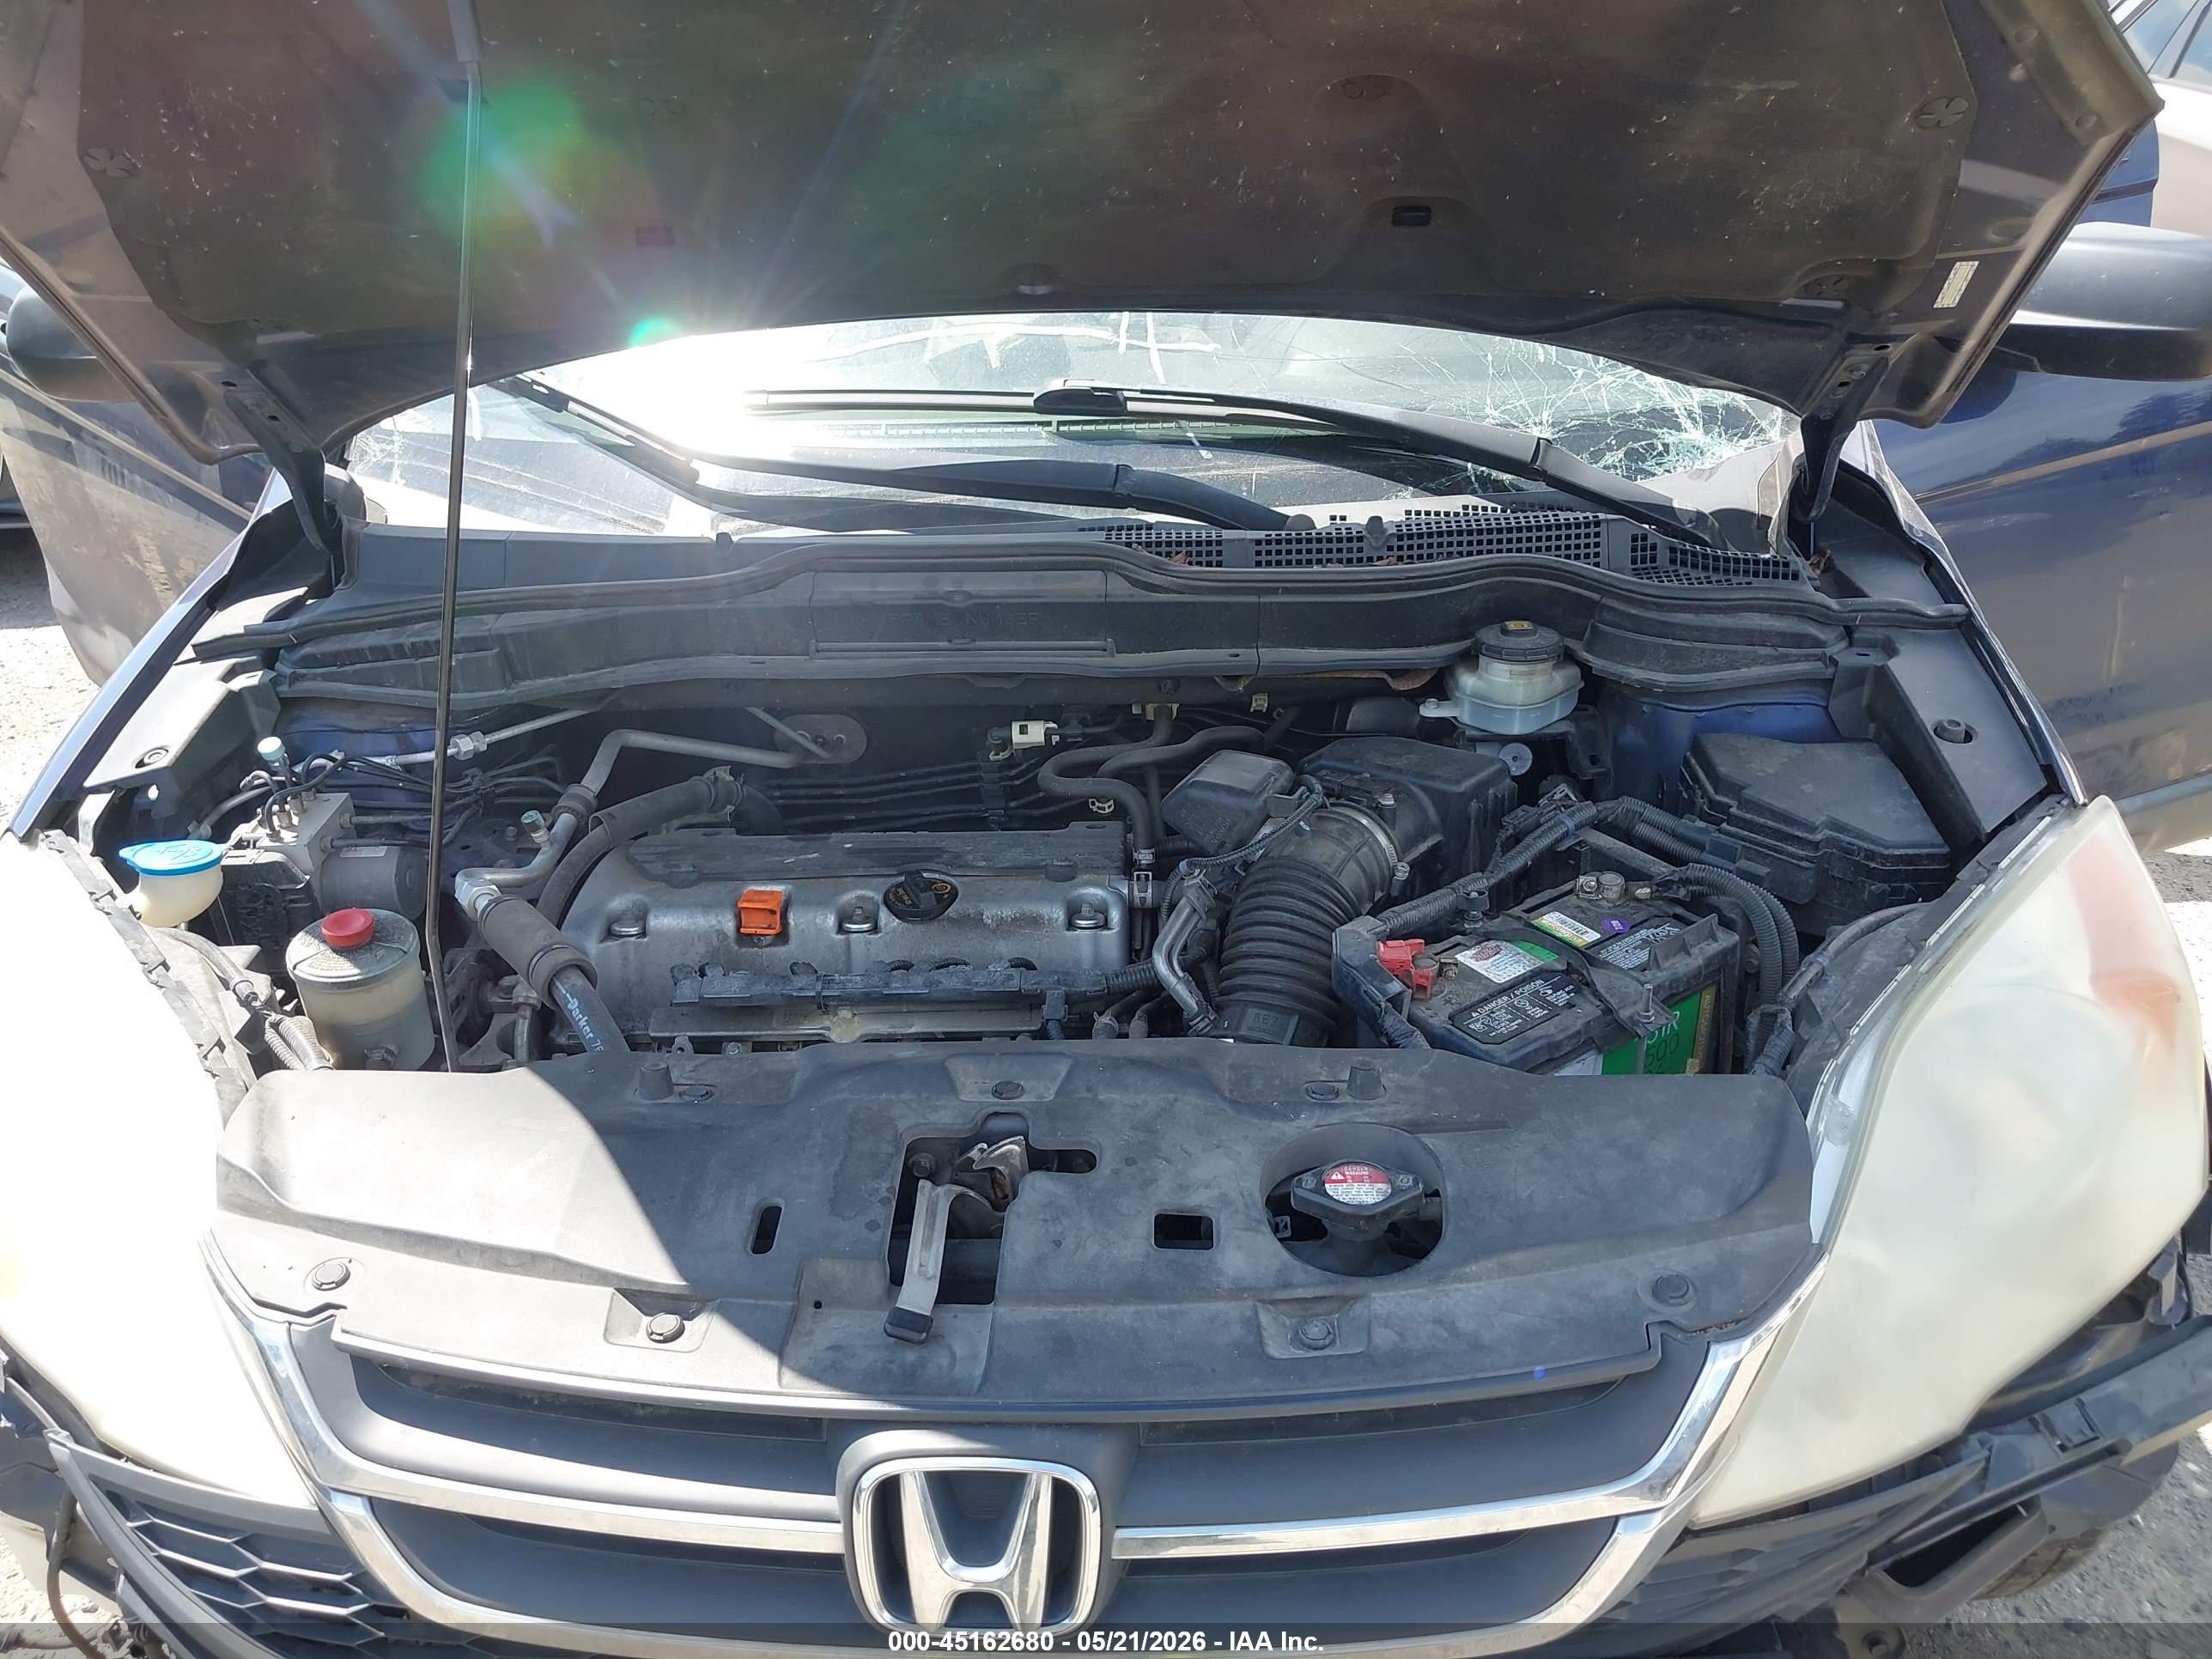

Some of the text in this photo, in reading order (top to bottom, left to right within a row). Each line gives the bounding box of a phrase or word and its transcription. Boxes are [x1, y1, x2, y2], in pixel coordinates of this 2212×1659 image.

[566, 993, 594, 1040] Parker
[1477, 995, 1511, 1014] DANGER
[1514, 979, 1545, 996] POISON
